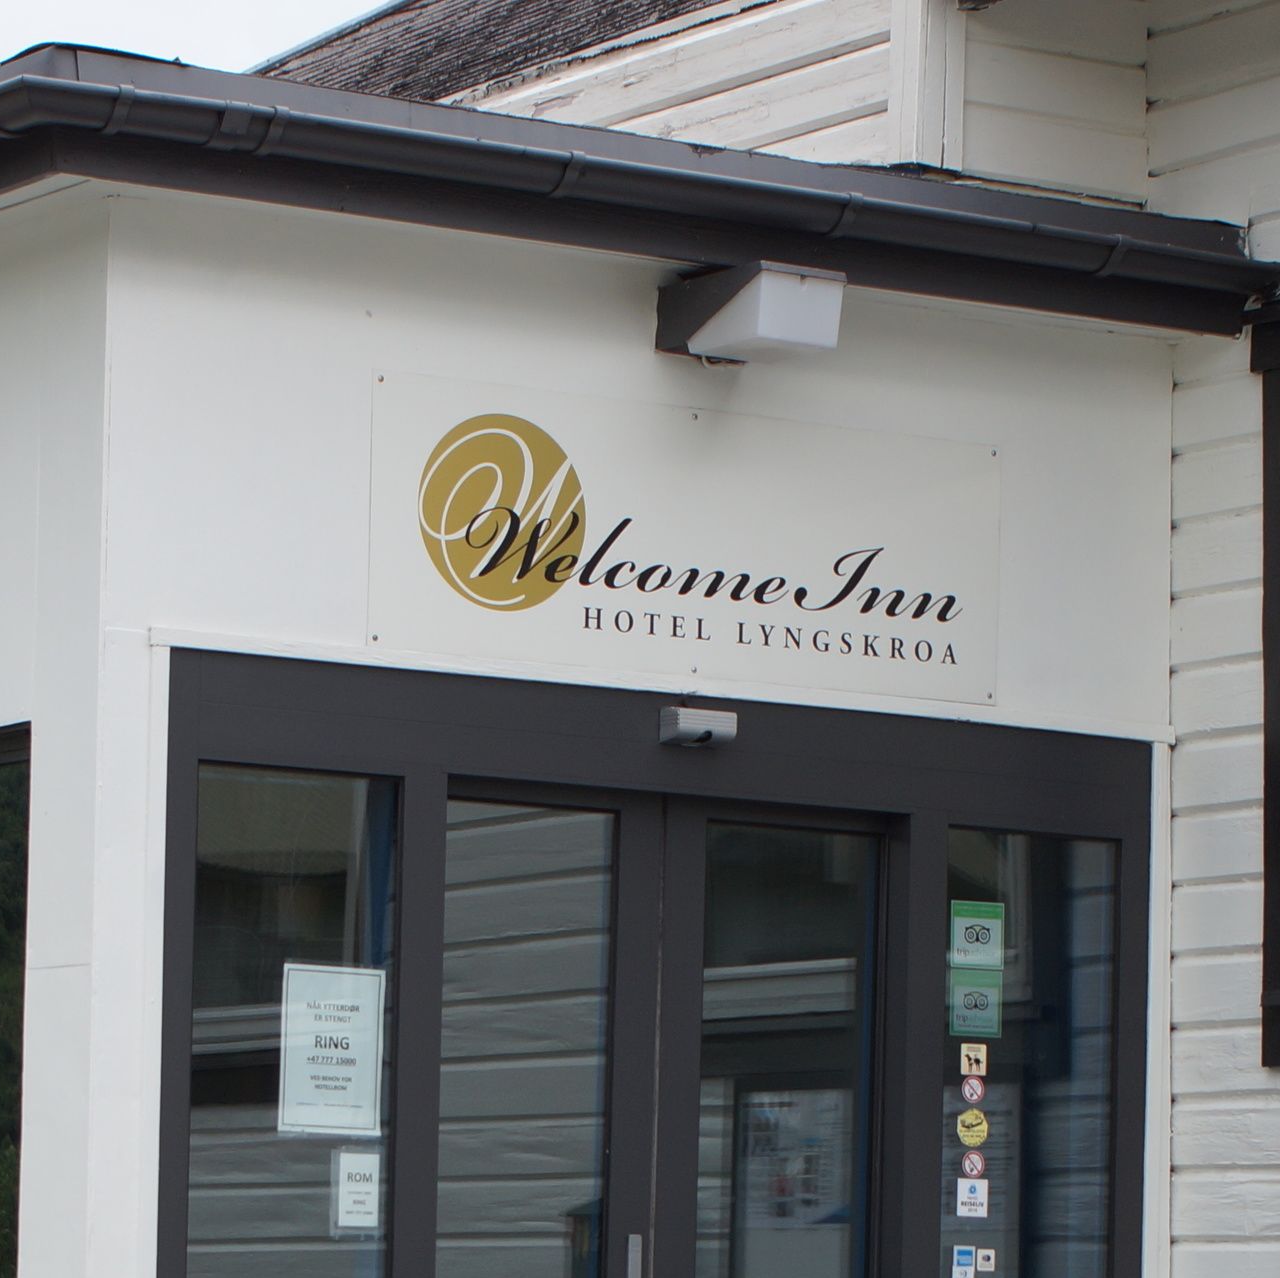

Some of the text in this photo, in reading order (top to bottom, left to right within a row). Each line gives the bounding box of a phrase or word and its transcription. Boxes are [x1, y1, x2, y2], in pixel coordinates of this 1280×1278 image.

[464, 505, 964, 624] Welcome Inn
[582, 605, 959, 666] HOTEL LYNGSKROA
[324, 1015, 352, 1024] STENGT
[314, 1034, 350, 1051] RING
[347, 1171, 373, 1183] ROM
